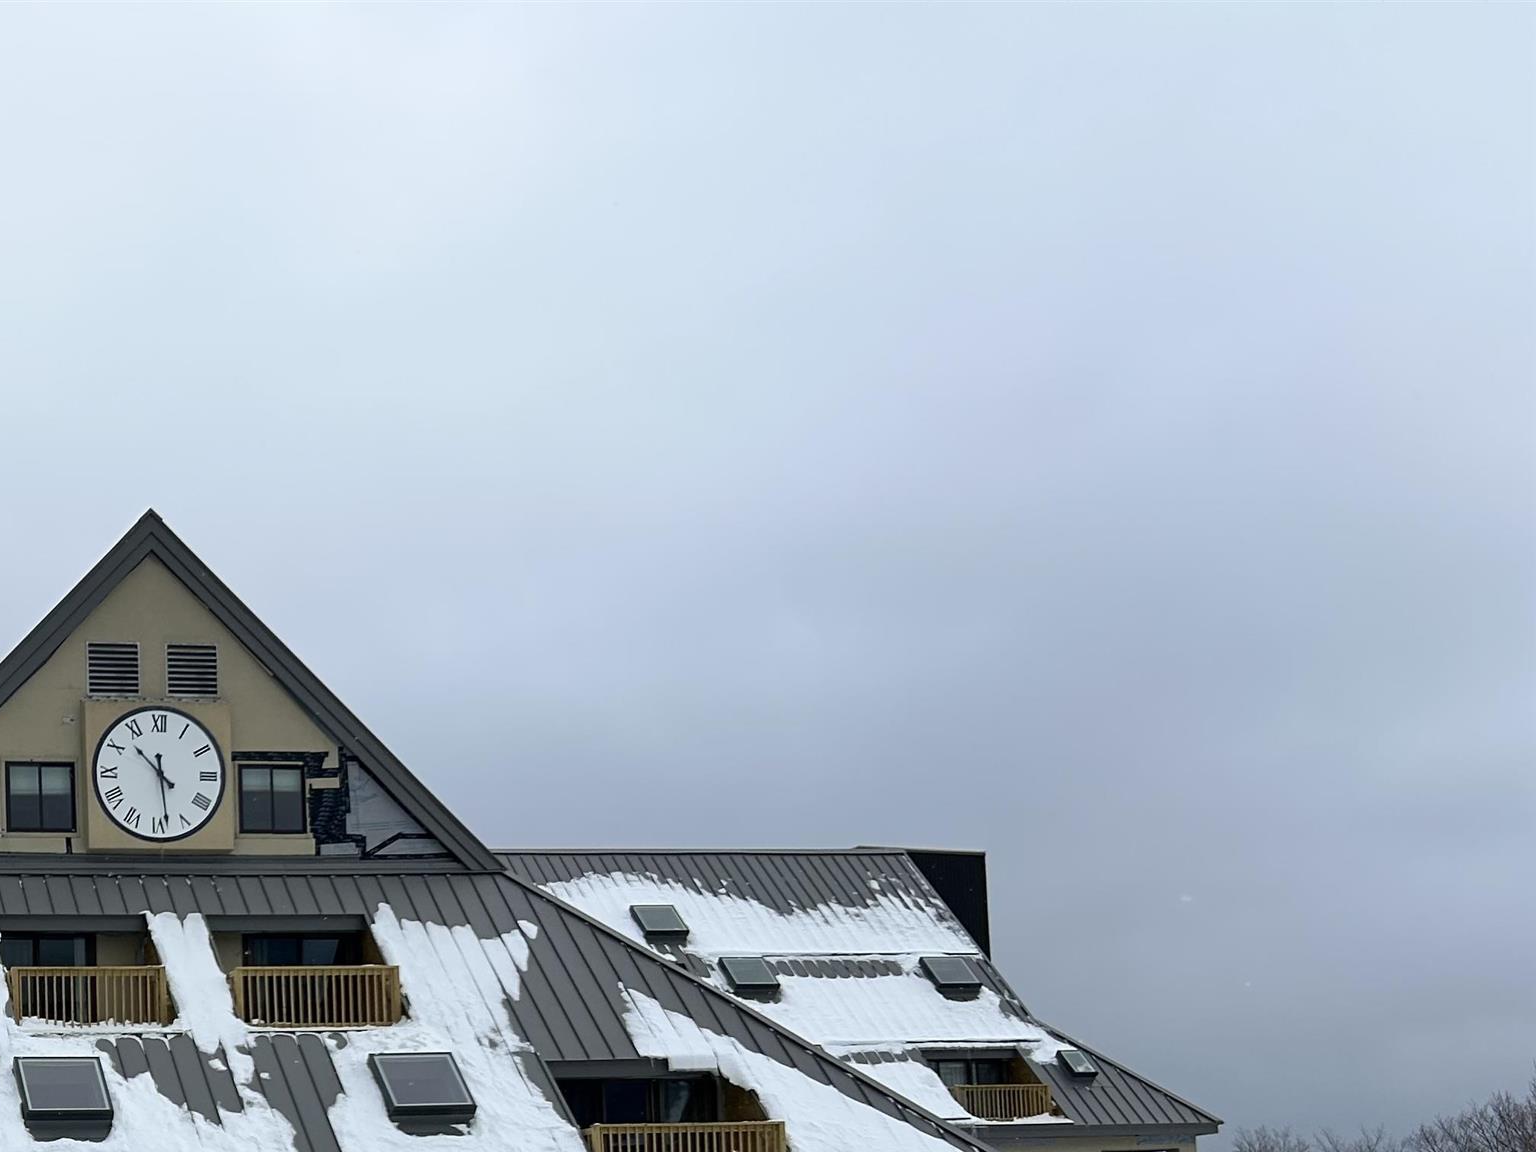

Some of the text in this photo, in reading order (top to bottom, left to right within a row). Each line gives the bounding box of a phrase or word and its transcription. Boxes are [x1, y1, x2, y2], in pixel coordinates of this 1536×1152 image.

[125, 719, 143, 740] XI
[151, 714, 168, 733] XII
[107, 738, 125, 755] X
[100, 765, 118, 779] IX
[200, 771, 217, 782] III
[104, 786, 124, 810] VIII
[123, 806, 141, 829] VII
[178, 814, 191, 829] V
